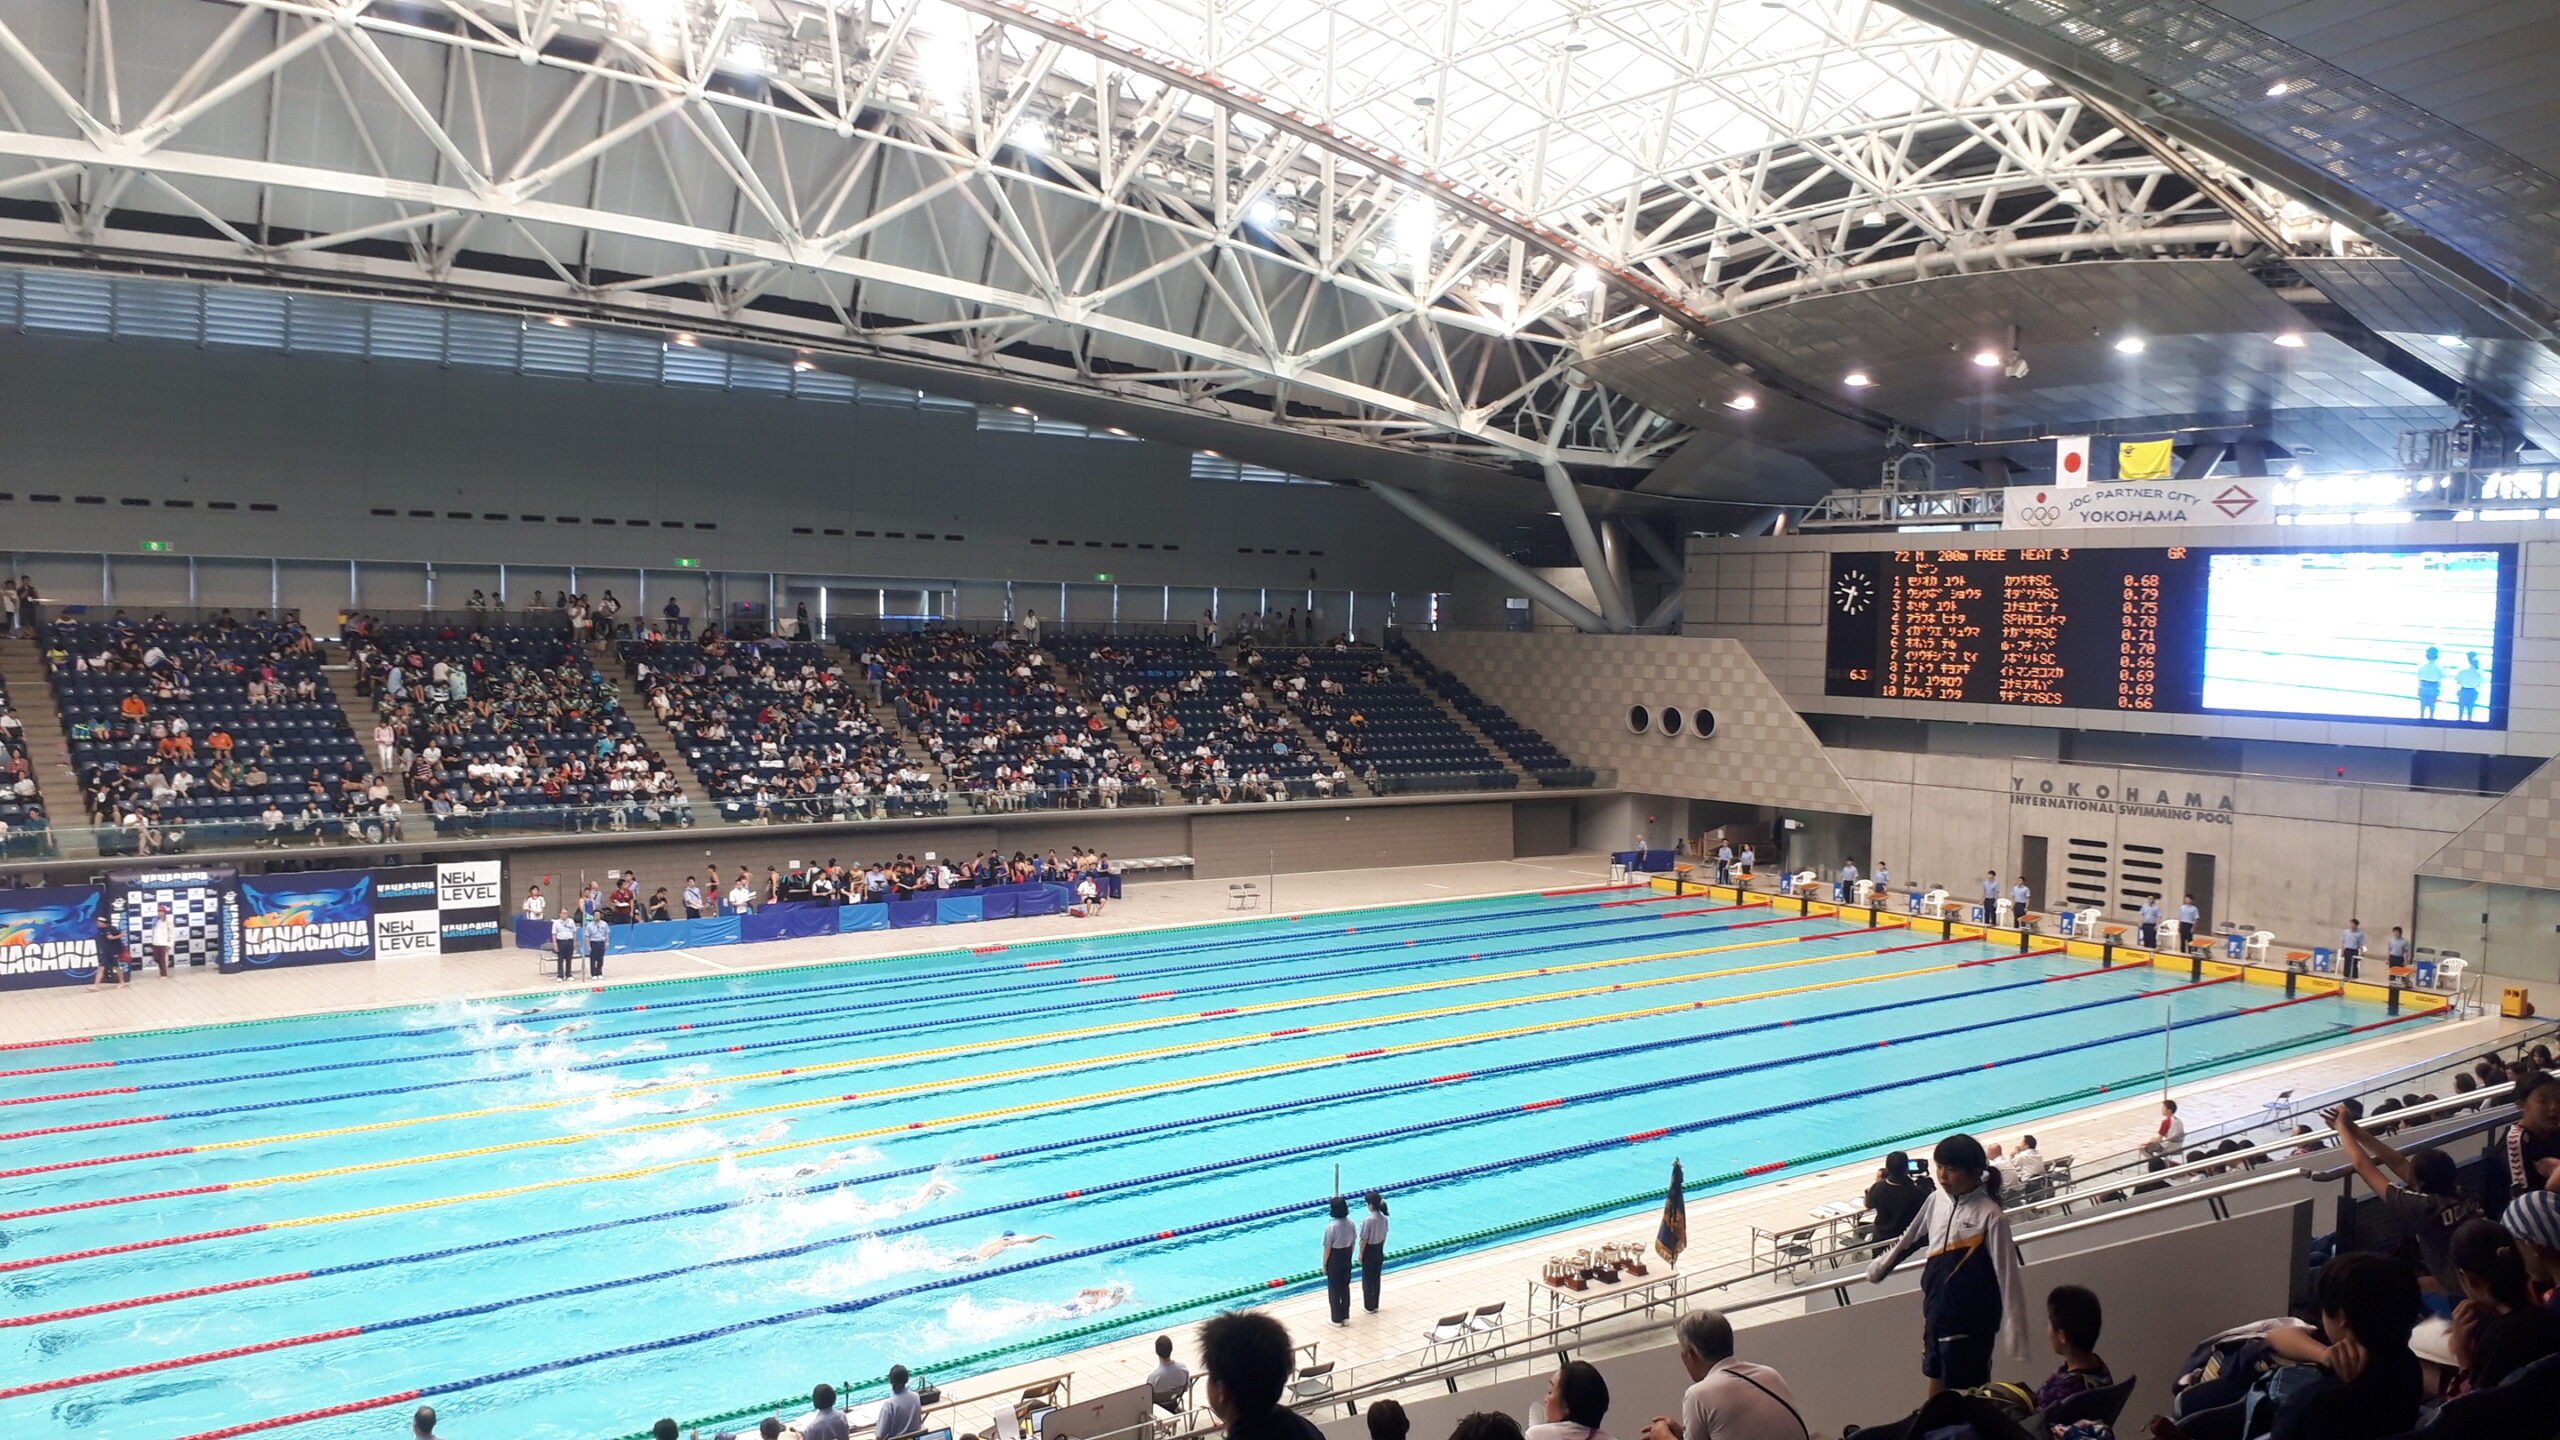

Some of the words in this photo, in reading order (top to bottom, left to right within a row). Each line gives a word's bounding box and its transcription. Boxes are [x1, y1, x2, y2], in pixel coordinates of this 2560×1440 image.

[2068, 494, 2092, 511] JOC
[2096, 488, 2163, 499] PARTNER
[2168, 491, 2201, 506] CITY
[2080, 510, 2187, 523] YOKOHAMA
[1895, 550, 1910, 561] 72
[1939, 550, 1968, 561] 200m
[1975, 549, 2006, 560] FREE
[2021, 548, 2053, 560] HEAT
[2061, 547, 2069, 559] 3
[2123, 629, 2154, 640] 0.71
[2120, 670, 2154, 681] 0.69
[2119, 683, 2153, 695] 0.69
[2012, 777, 2233, 810] YOKOHAMA
[2011, 794, 2114, 813] INTERNATIONAL
[2119, 804, 2193, 821] SWIMMING
[2196, 811, 2233, 825] POOL
[441, 872, 475, 884] NEW
[377, 881, 435, 898] KANAGAWA
[442, 887, 496, 901] LEVEL
[379, 920, 414, 934] NEW
[245, 920, 369, 955] KANAGAWA
[380, 936, 436, 950] LEVEL
